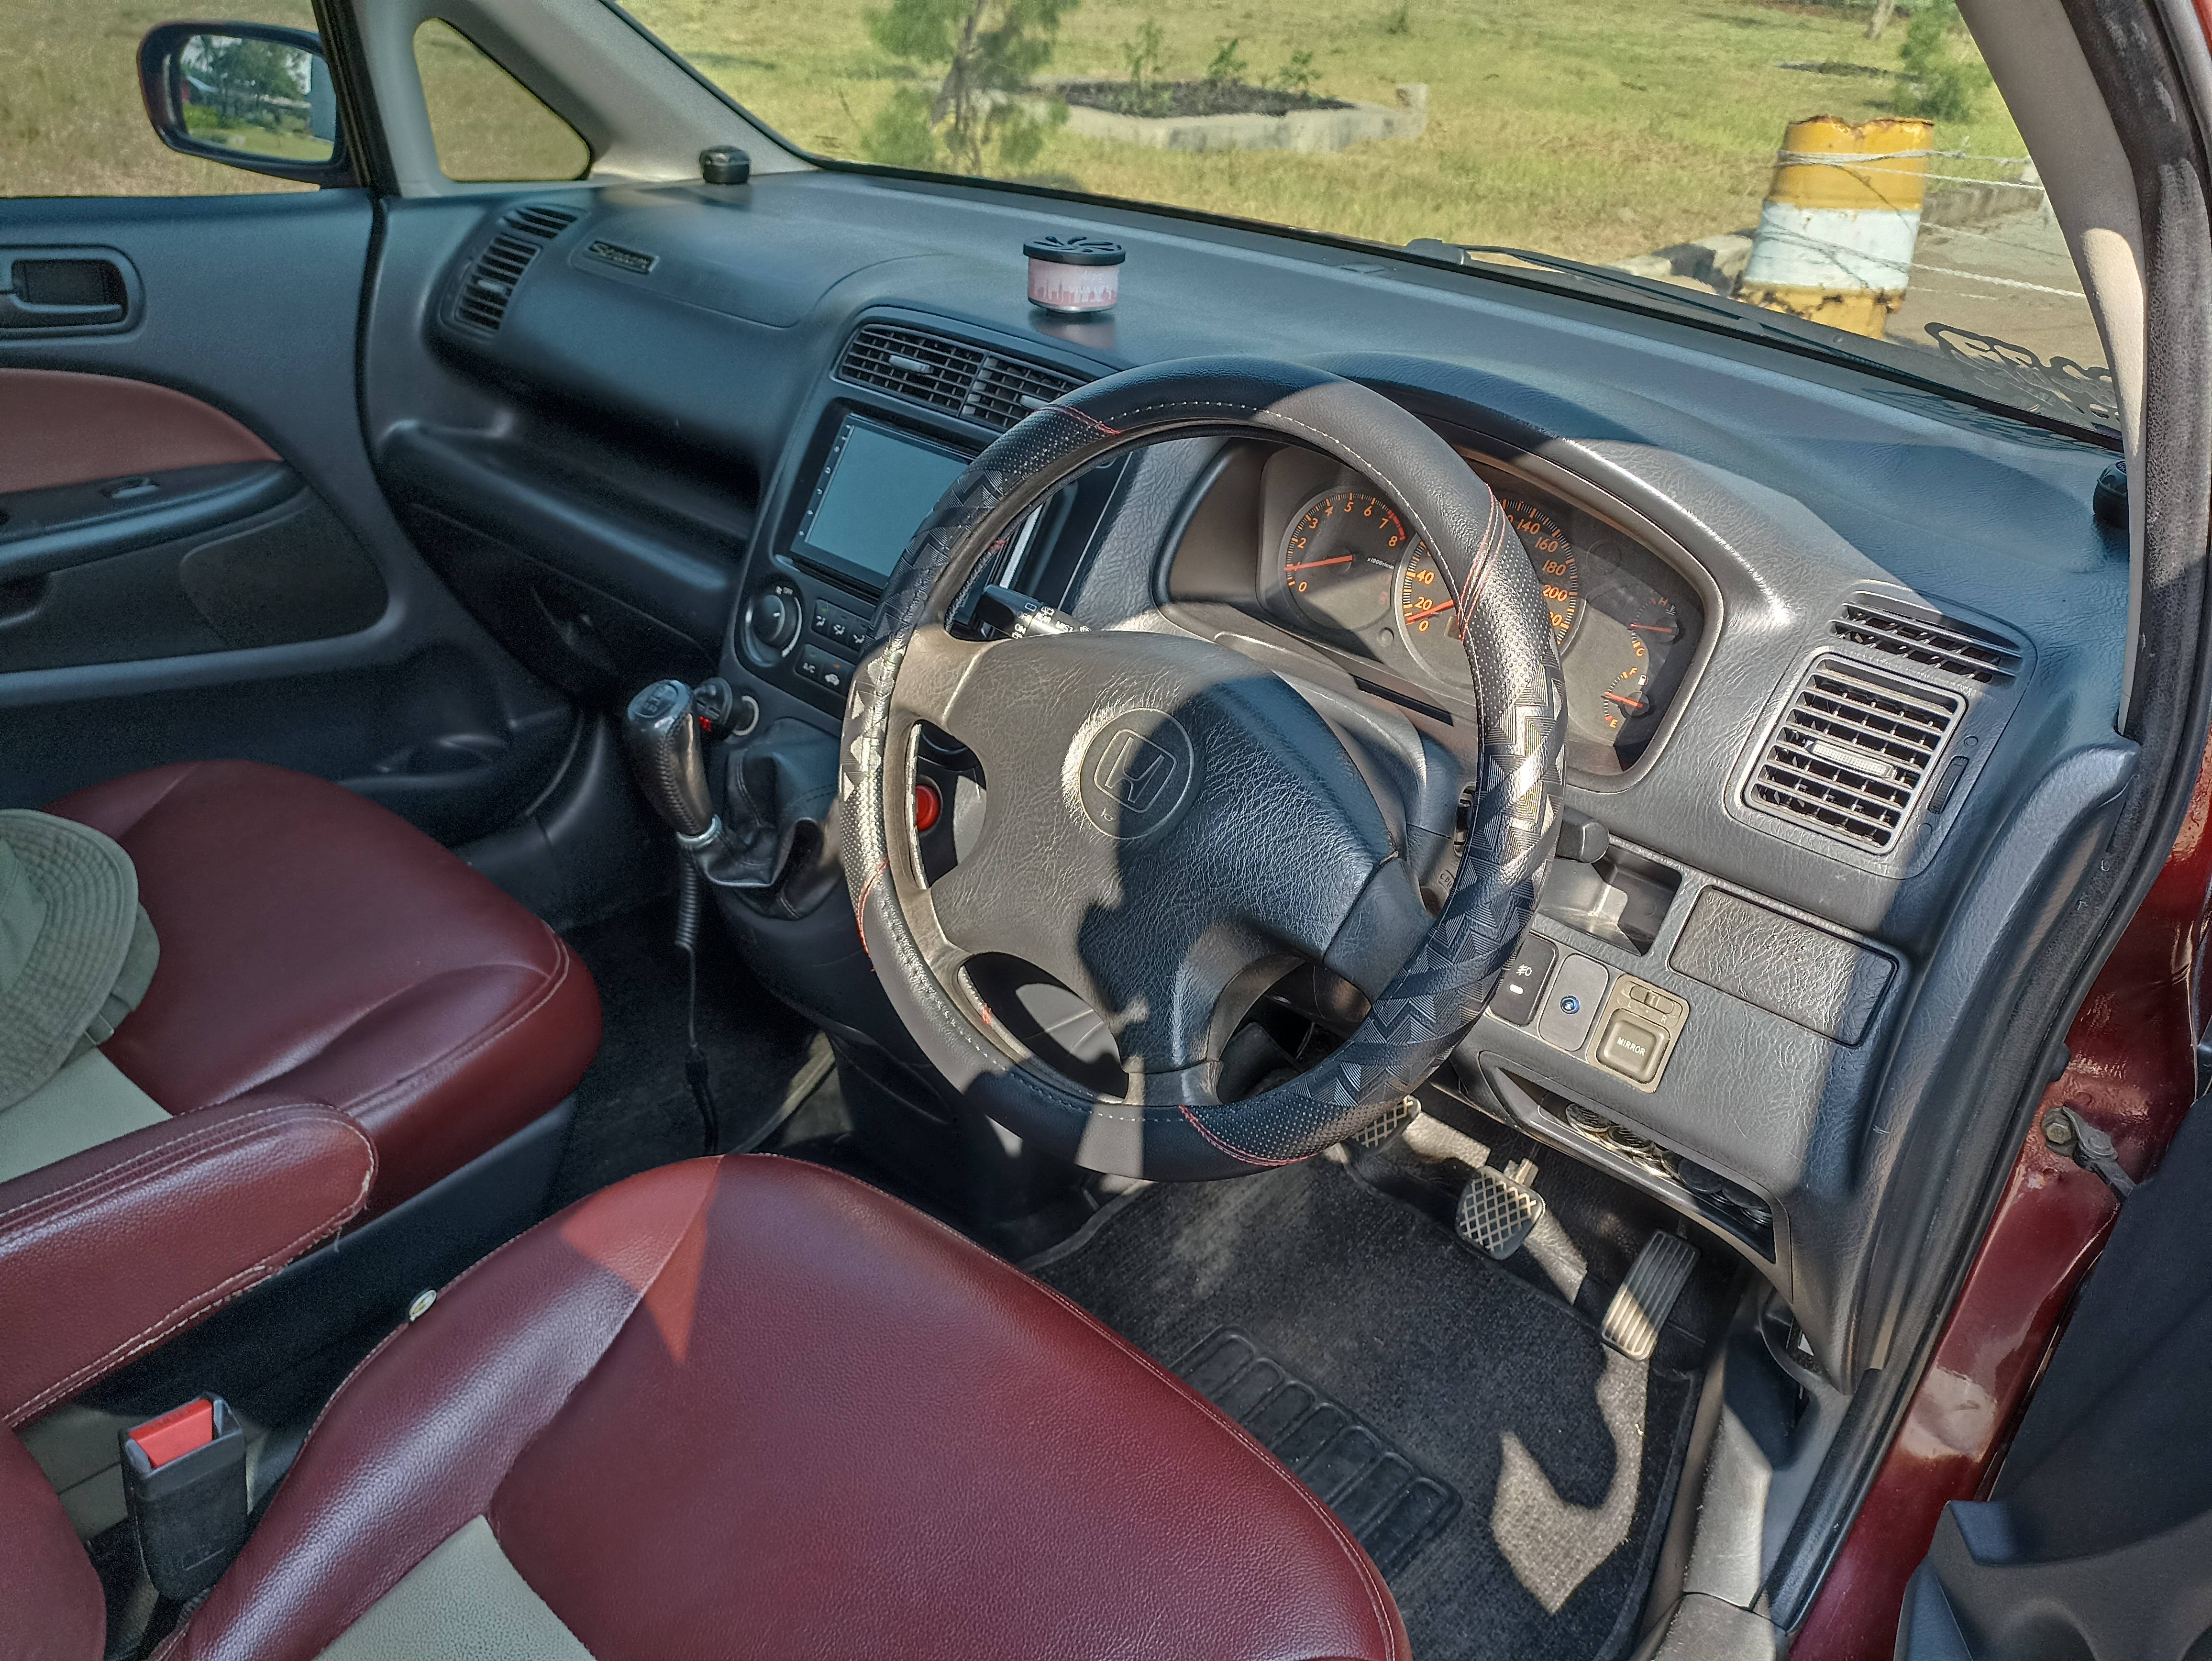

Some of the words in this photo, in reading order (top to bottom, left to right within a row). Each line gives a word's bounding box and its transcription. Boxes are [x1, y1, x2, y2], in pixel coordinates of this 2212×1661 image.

[1325, 506, 1334, 516] 4
[1344, 501, 1354, 512] 5
[1364, 506, 1372, 516] 6
[1309, 518, 1318, 529] 3
[1379, 518, 1389, 529] 7
[1517, 519, 1540, 534] 140
[1297, 537, 1306, 549] 2
[1388, 535, 1398, 547] 8
[1535, 537, 1558, 553] 160
[1542, 559, 1566, 576] 180
[1416, 570, 1434, 584] 40
[1298, 581, 1307, 592] 0
[1543, 584, 1568, 601] 200
[1415, 596, 1432, 610] 20
[1658, 597, 1669, 606] H
[1419, 620, 1429, 631] 0
[1636, 647, 1645, 657] C
[1629, 666, 1638, 675] F
[1609, 719, 1618, 729] E
[1627, 999, 1632, 1008] L
[1660, 1014, 1668, 1024] R
[1617, 1037, 1646, 1056] MIRROR
